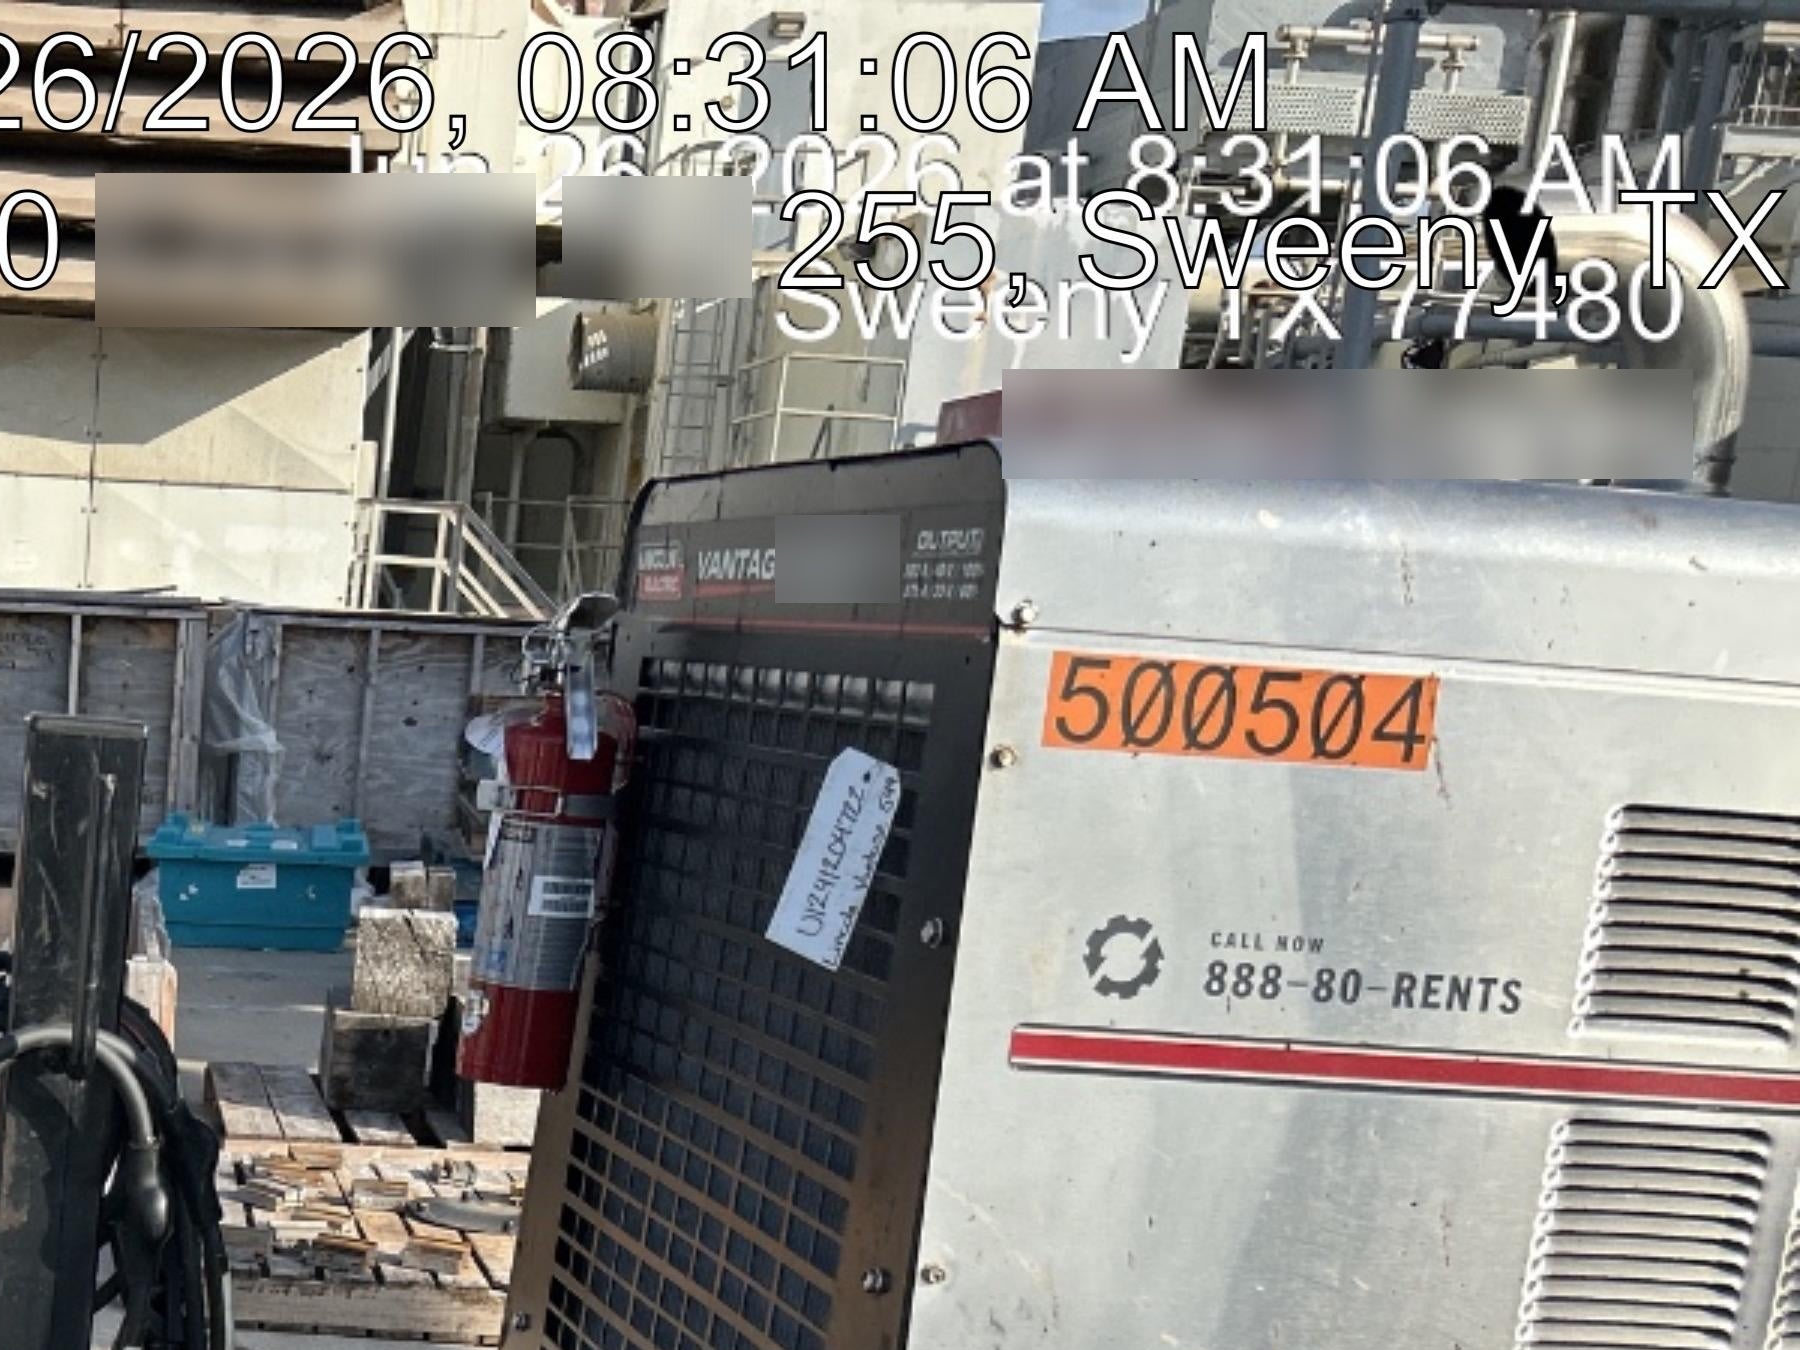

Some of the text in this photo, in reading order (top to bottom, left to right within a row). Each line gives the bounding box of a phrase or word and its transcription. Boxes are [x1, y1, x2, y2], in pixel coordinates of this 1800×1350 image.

[1055, 655, 1427, 763] 500504
[1211, 931, 1324, 954] CALL NOW
[1203, 958, 1523, 1015] 888-80-RENTS
